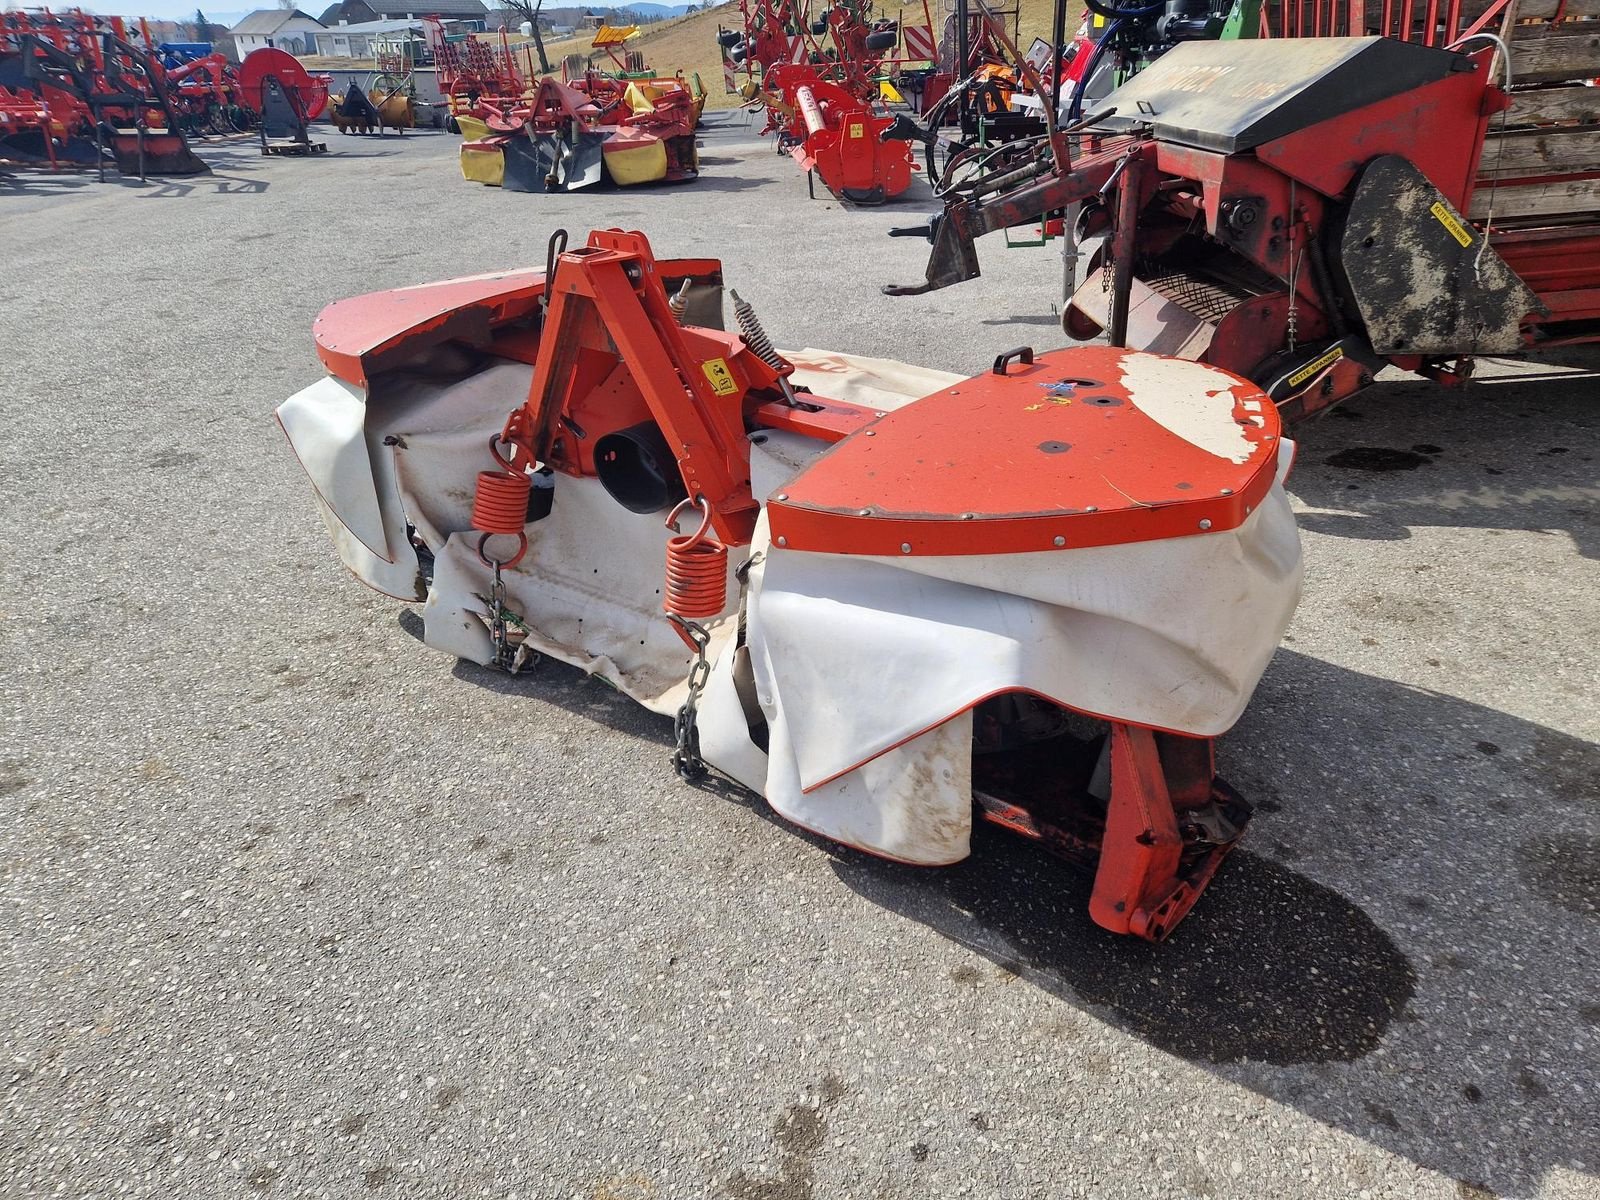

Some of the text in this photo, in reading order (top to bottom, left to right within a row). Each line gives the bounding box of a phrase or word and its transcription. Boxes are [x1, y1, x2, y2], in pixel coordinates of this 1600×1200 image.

[1433, 206, 1448, 223] KETTE
[1291, 350, 1341, 385] KETTE SPANNEN
